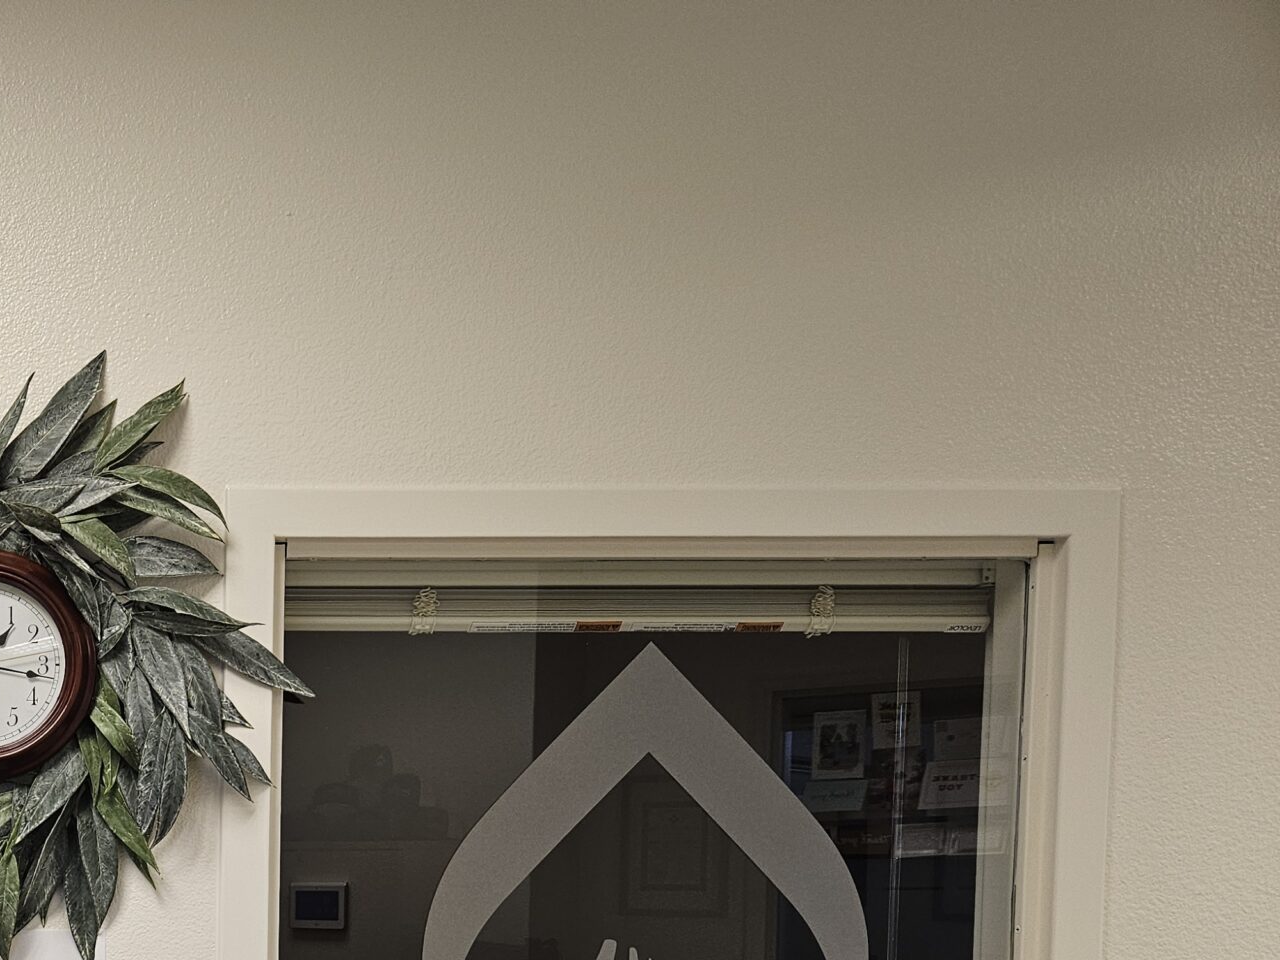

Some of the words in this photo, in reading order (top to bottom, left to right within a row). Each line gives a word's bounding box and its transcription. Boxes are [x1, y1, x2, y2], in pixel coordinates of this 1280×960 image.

[8, 606, 14, 625] 1
[28, 624, 39, 644] 2
[38, 655, 49, 675] 3
[26, 687, 38, 706] 4
[6, 707, 18, 727] 5
